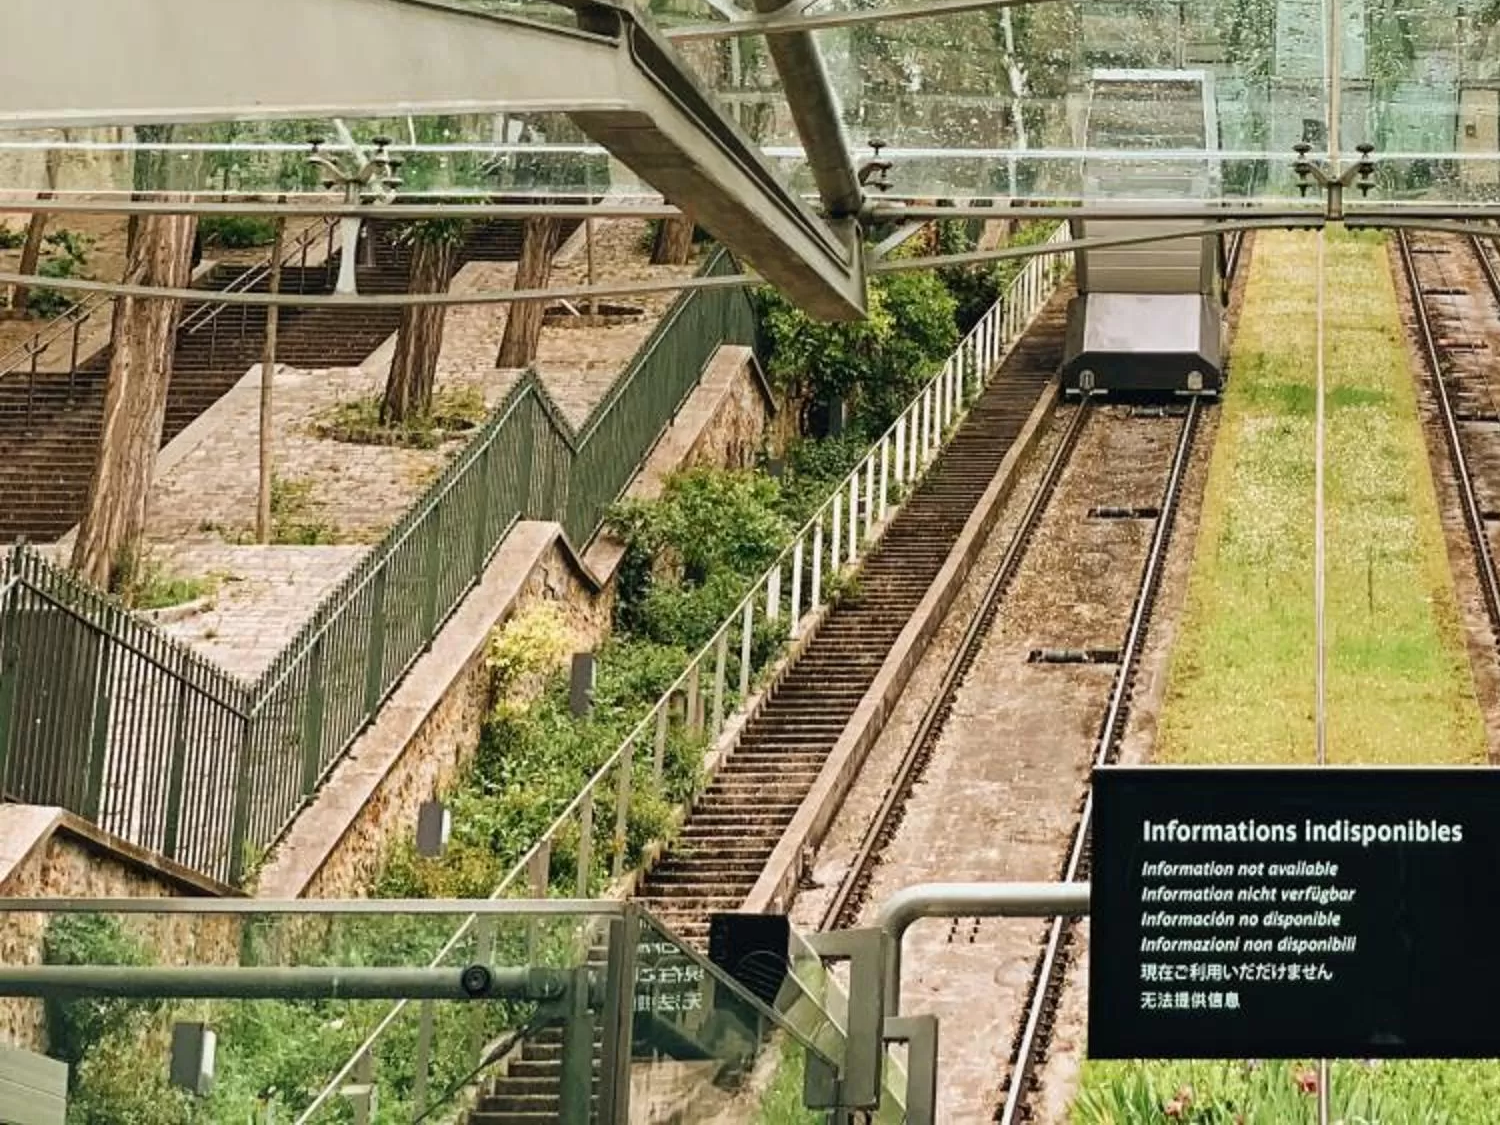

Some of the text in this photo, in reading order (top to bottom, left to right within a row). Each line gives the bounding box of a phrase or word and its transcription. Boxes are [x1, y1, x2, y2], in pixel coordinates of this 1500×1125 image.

[1143, 818, 1463, 848] Informations indisponibles
[1141, 860, 1339, 877] Information not available
[1141, 885, 1357, 906] Information nicht verfügbar
[1140, 910, 1341, 930] Información no disponible
[1140, 935, 1357, 956] Informazioni non disponibili
